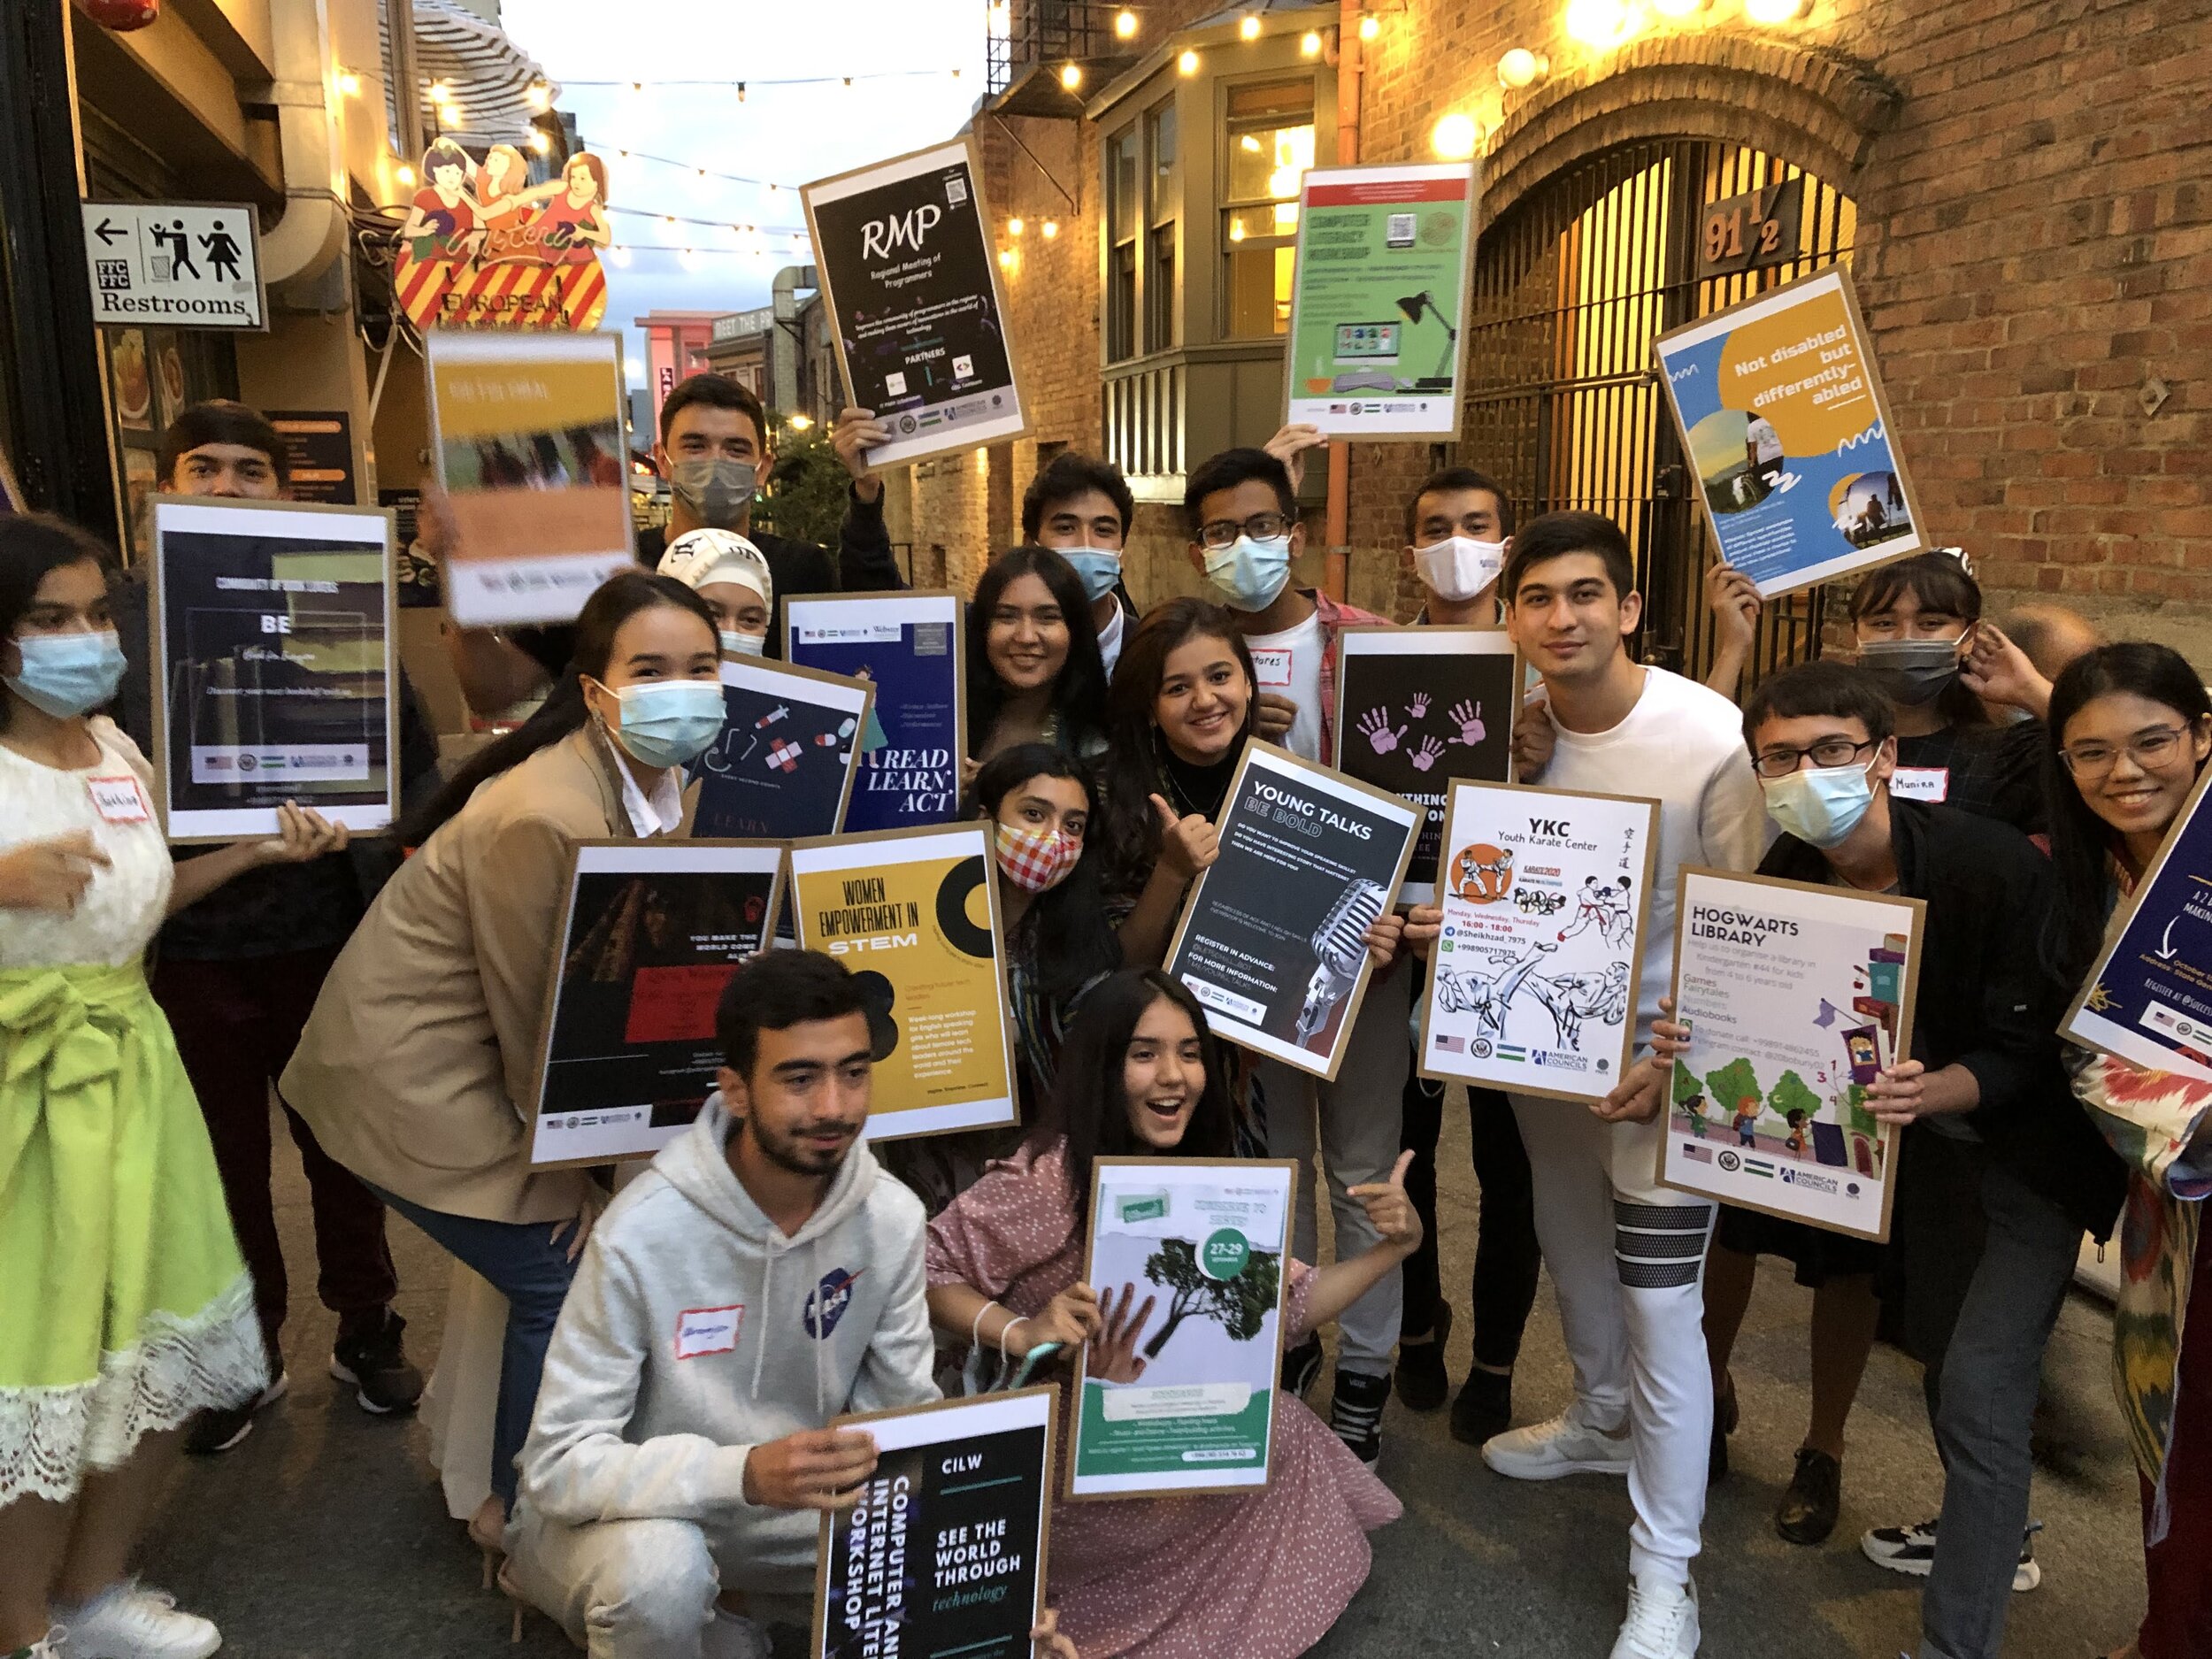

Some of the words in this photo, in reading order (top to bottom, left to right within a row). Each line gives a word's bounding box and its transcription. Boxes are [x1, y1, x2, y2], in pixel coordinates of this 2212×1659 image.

[860, 204, 941, 260] RMP
[1705, 206, 1742, 263] 91
[97, 261, 127, 274] FFC
[871, 263, 900, 280] Regional
[902, 257, 932, 271] Meeting
[933, 252, 941, 263] of
[100, 274, 130, 288] FFC
[885, 270, 933, 289] Programmers
[100, 291, 246, 315] Restrooms
[442, 293, 563, 311] EUROPEAN
[905, 347, 946, 365] PARTNERS
[1734, 356, 1768, 378] Not
[1770, 324, 1847, 364] disabled
[1820, 342, 1853, 364] but
[1754, 364, 1848, 408] differently
[1812, 376, 1863, 404] abled
[260, 614, 293, 634] BE
[884, 749, 949, 770] READ
[867, 770, 951, 791] LEARN
[899, 789, 954, 813] ACT
[1254, 780, 1315, 818] YOUNG
[1319, 807, 1372, 841] TALKS
[1244, 795, 1271, 818] BE
[1272, 806, 1323, 839] BOLD
[1529, 818, 1571, 837] YKC
[1241, 833, 1253, 843] YOU
[1253, 838, 1266, 849] HAVE
[1422, 832, 1441, 841] HIN
[1498, 830, 1525, 844] Youth
[1529, 834, 1562, 849] Karate
[1564, 838, 1598, 852] Center
[1253, 849, 1263, 857] ARE
[842, 877, 886, 906] WOMEN
[2193, 890, 2200, 901] A
[818, 903, 902, 938] EMPOWERMENT
[907, 902, 919, 928] IN
[1462, 920, 1484, 929] 16:00
[1491, 924, 1513, 933] 18:00
[1512, 917, 1540, 928] Thursday
[1693, 905, 1799, 937] HOGWARTS
[828, 933, 918, 956] STEM
[1194, 933, 1229, 953] REGISTER
[1229, 948, 1239, 956] IN
[1691, 922, 1767, 947] LIBRARY
[1187, 951, 1203, 963] FOR
[1204, 957, 1225, 972] MORE
[1721, 944, 1730, 953] to
[1778, 954, 1806, 969] library
[1705, 966, 1725, 975] from
[1734, 972, 1744, 981] to
[1754, 978, 1777, 987] years
[1778, 979, 1793, 990] old
[1772, 965, 1784, 974] for
[1786, 969, 1804, 979] kids
[2174, 960, 2205, 977] October
[2174, 969, 2195, 982] State
[1683, 973, 1717, 987] Games
[2144, 978, 2173, 997] REGISTER
[2172, 991, 2183, 1002] AT
[1683, 983, 1730, 999] Fairytales
[1681, 1005, 1737, 1024] Audiobooks
[1547, 1057, 1587, 1070] COUNCILS
[1548, 1051, 1588, 1063] AMERICAN
[1816, 1071, 1827, 1082] 3
[1830, 1095, 1838, 1106] 4
[1795, 1176, 1838, 1193] COUNCILS
[1796, 1171, 1839, 1187] AMERICAN
[1210, 1242, 1243, 1255] 27-29
[941, 1453, 983, 1475] CILW
[866, 1479, 890, 1598] INTERNET
[885, 1475, 910, 1611] COMPUTER
[936, 1526, 968, 1548] SEE
[974, 1518, 1007, 1540] THE
[934, 1540, 1002, 1568] WORLD
[933, 1555, 1021, 1589] THROUGH
[932, 1584, 1009, 1613] technology
[863, 1604, 882, 1659] LITE
